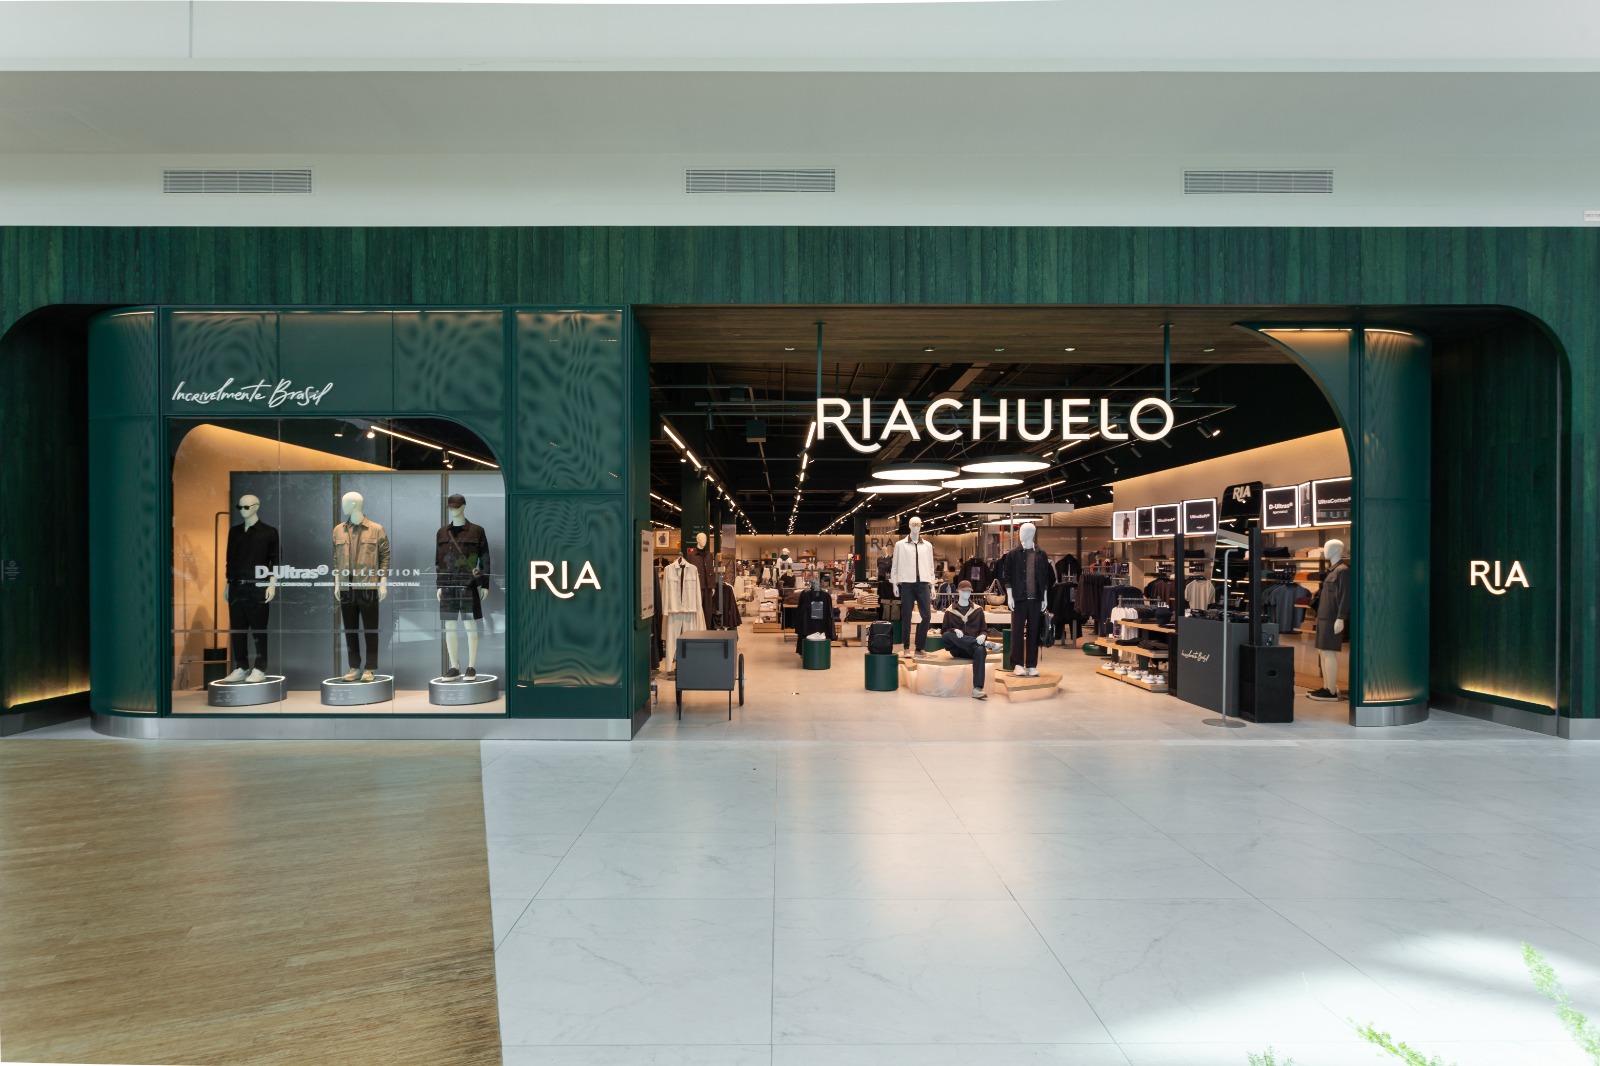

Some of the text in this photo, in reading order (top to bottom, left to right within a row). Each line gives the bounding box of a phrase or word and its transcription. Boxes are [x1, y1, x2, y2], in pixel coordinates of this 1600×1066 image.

[171, 377, 333, 408] Incrivelmente Brasil
[816, 397, 1175, 453] RIACHUELO
[1232, 485, 1252, 503] RIA
[870, 537, 894, 550] RIA
[331, 568, 421, 577] COLLECTION
[530, 560, 602, 599] RIA
[1470, 560, 1530, 595] RIA
